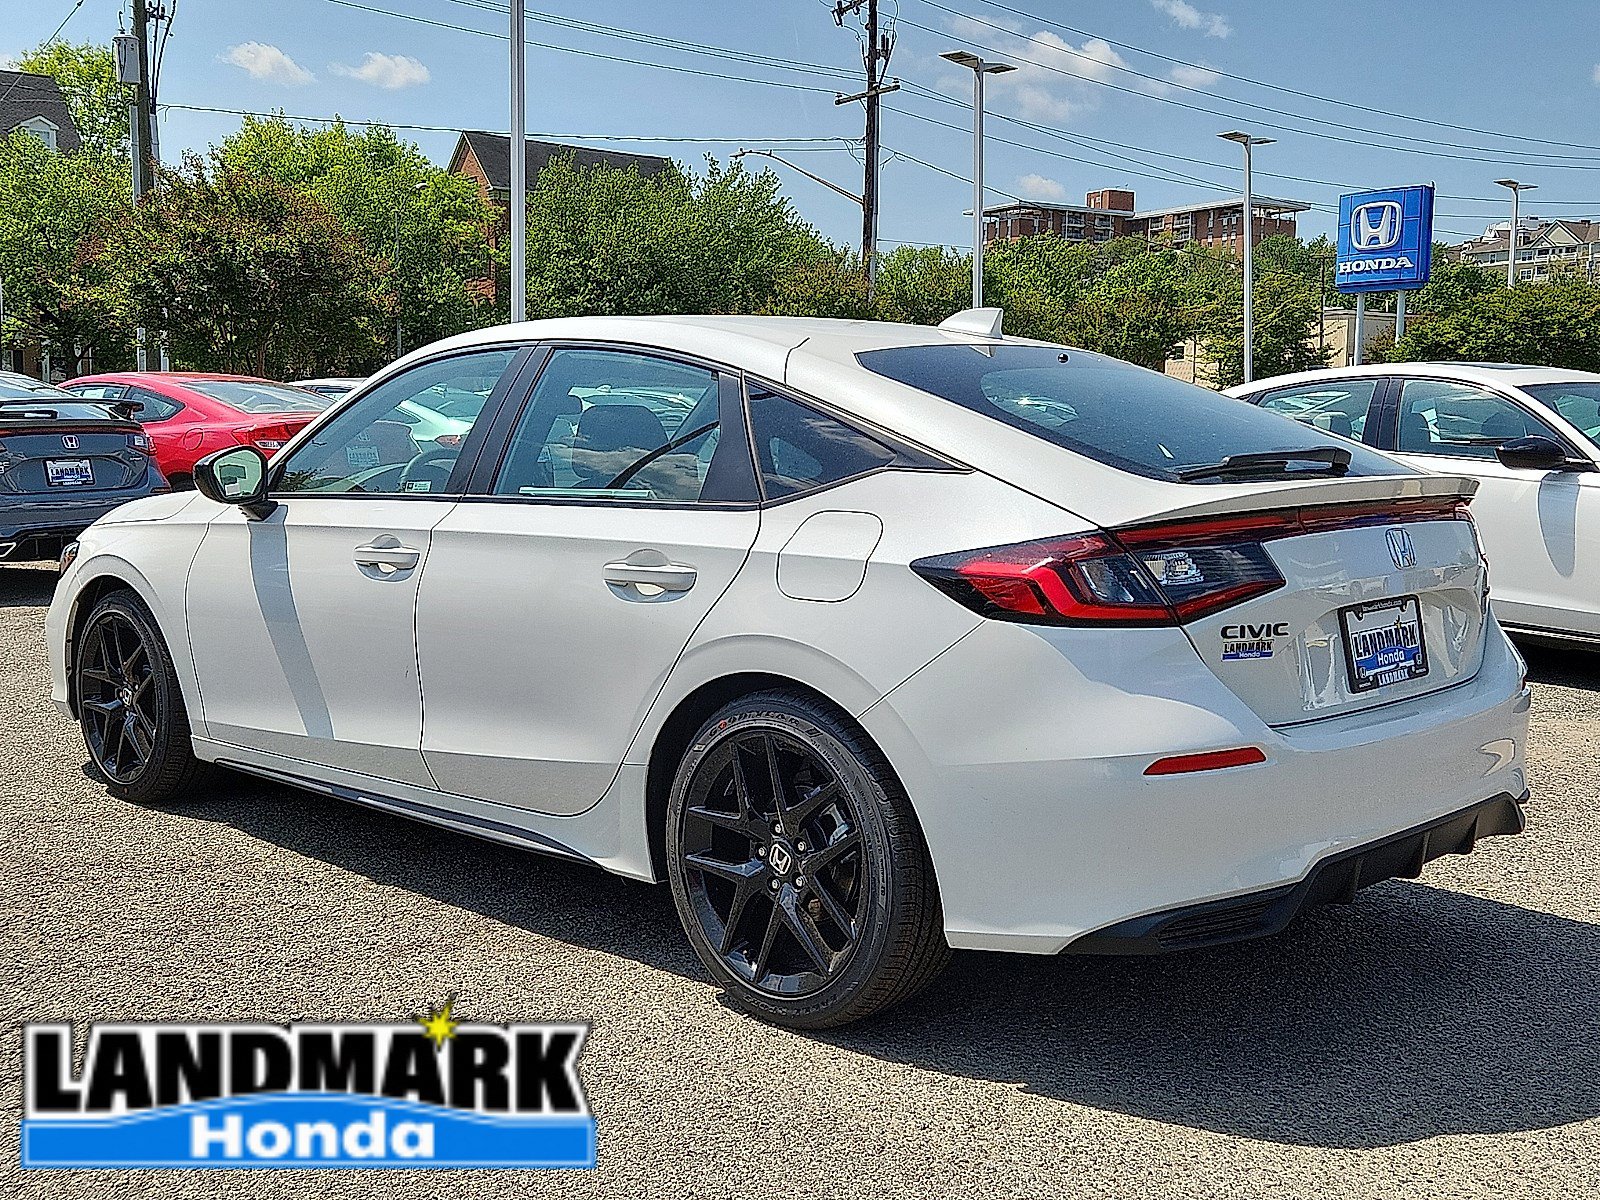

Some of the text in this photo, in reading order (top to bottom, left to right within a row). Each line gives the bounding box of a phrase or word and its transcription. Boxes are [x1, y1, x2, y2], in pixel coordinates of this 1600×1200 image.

[1338, 256, 1414, 274] HONDA
[1220, 622, 1289, 638] CIVIC
[1224, 641, 1273, 653] LANDMARK
[1353, 623, 1418, 660] LANDMARK
[1377, 649, 1405, 666] Honda
[1377, 668, 1409, 686] LANDMARK
